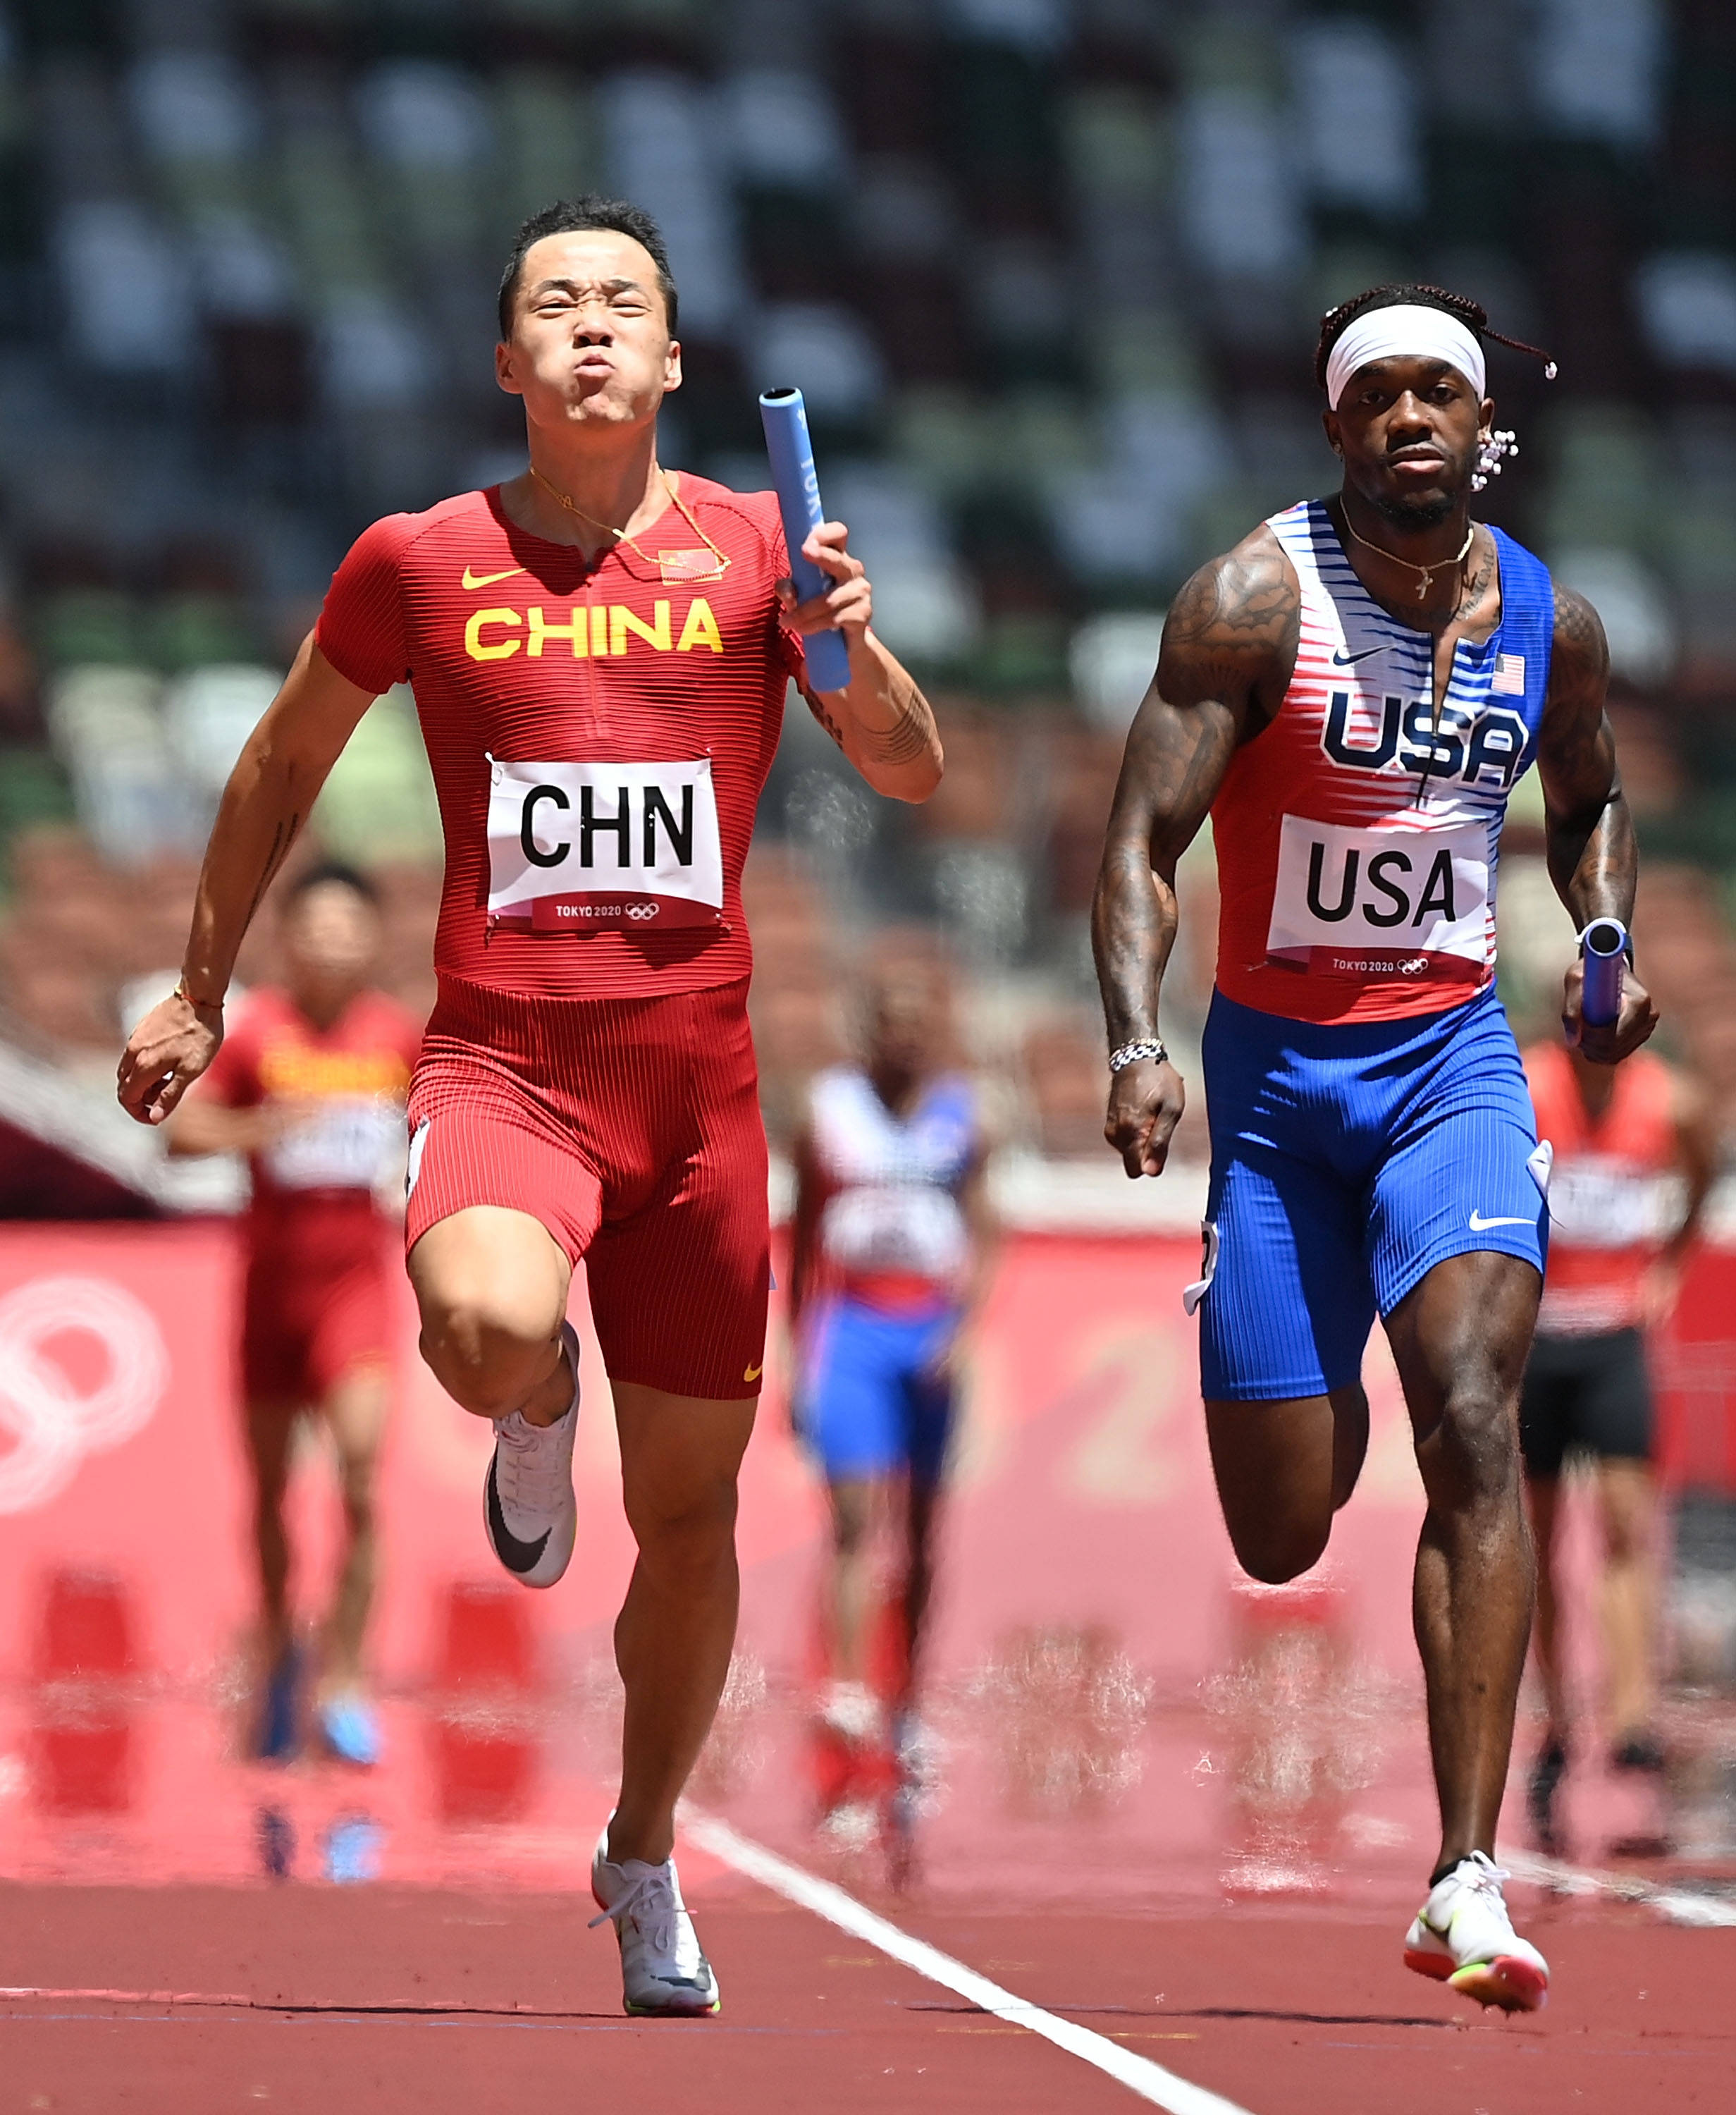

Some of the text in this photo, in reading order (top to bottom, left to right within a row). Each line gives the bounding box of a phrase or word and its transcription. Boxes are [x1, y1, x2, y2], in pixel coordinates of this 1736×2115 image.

[465, 598, 724, 661] CHINA
[1320, 689, 1529, 792] USA
[520, 784, 694, 869] CHN
[555, 905, 622, 917] TOKYO 2020
[1306, 842, 1456, 928] USA
[1333, 958, 1394, 972] TOKYO 2020
